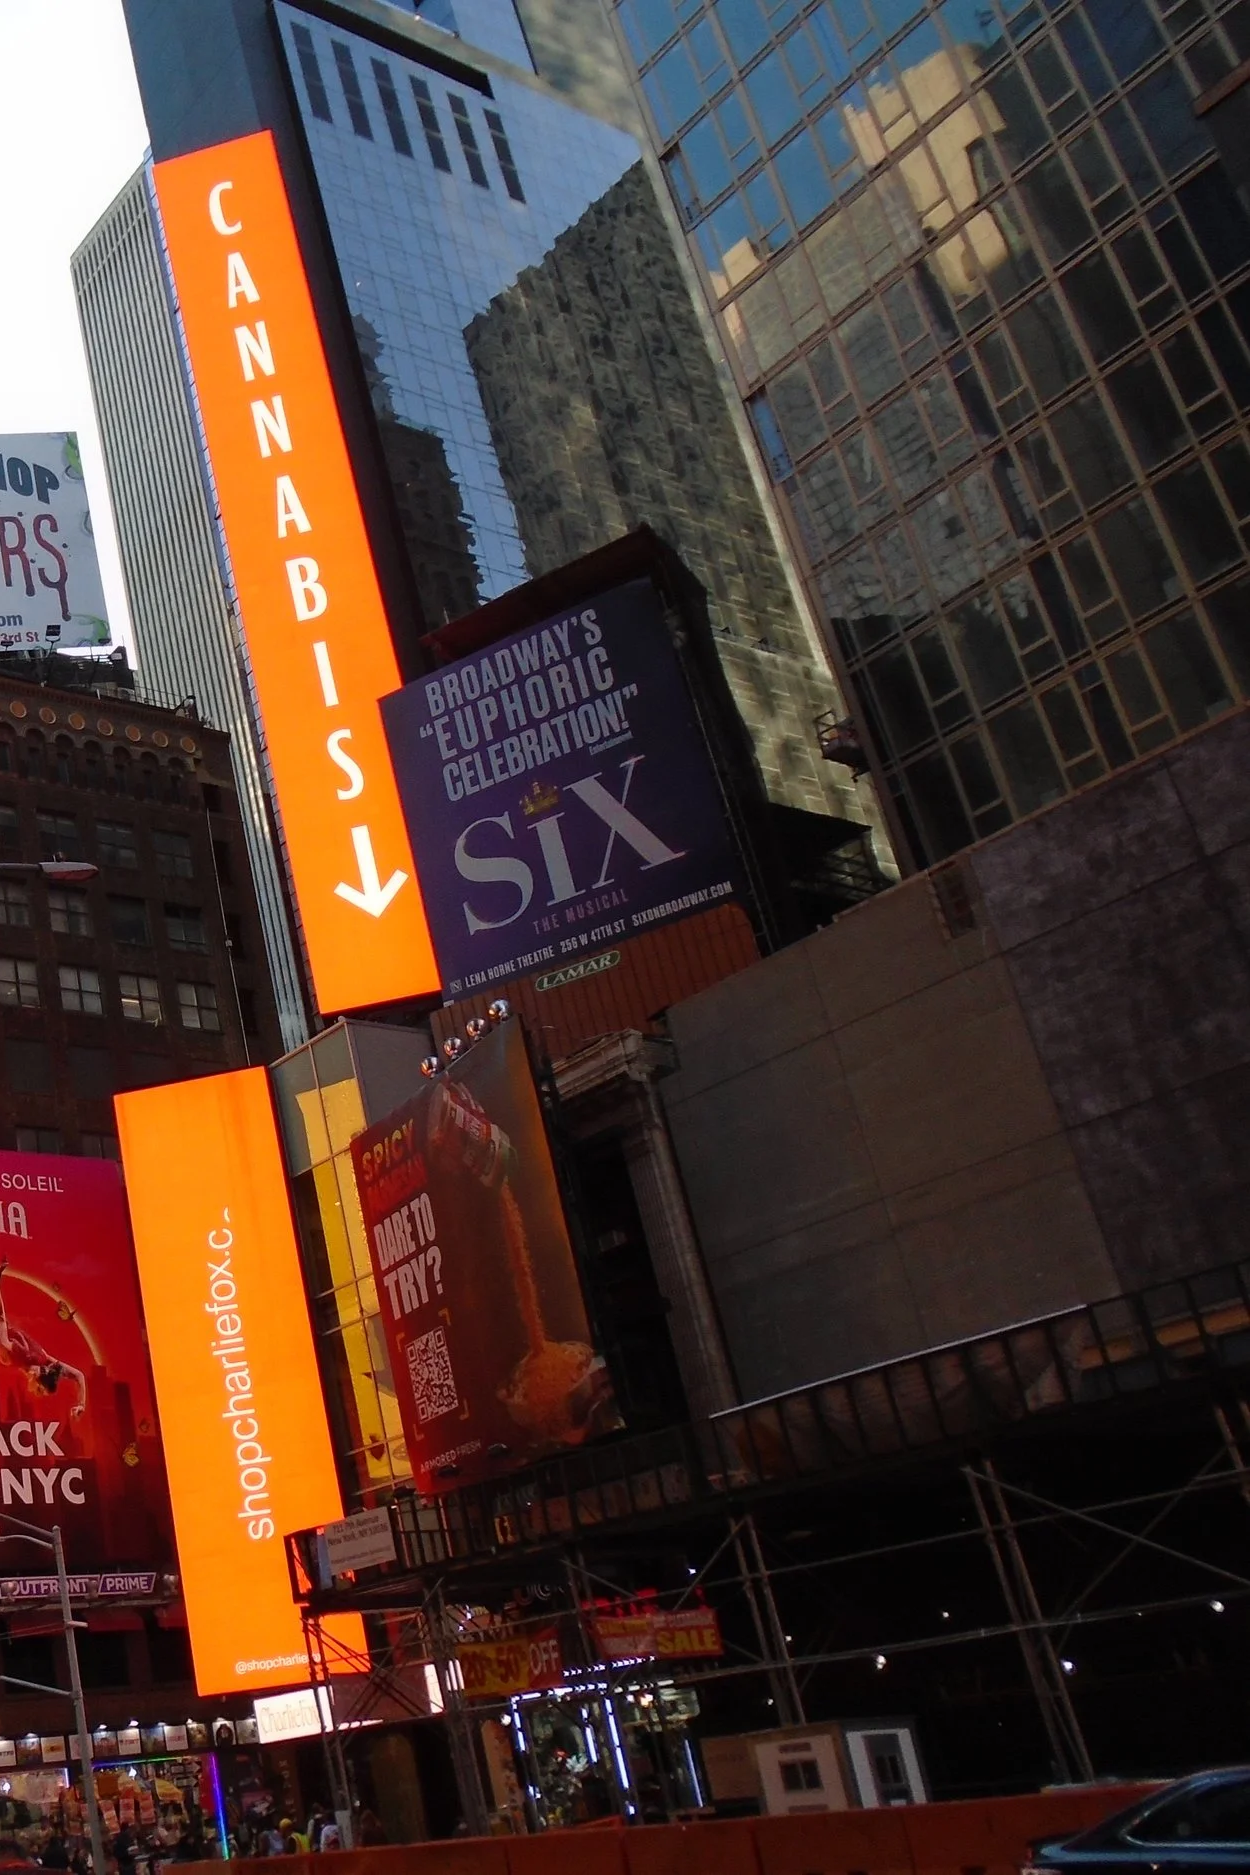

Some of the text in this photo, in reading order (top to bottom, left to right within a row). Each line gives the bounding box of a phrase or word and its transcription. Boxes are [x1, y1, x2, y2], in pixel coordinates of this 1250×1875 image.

[209, 181, 366, 801] CANNABIS
[26, 630, 40, 642] St
[425, 608, 602, 717] BROADWAY'S
[454, 755, 686, 936] SIX
[465, 971, 487, 988] LENA
[488, 961, 517, 979] HORNE
[517, 945, 555, 972] THEATRE
[579, 932, 589, 947] W
[590, 924, 613, 943] 47TH
[614, 918, 626, 936] ST
[632, 880, 735, 928] SIXONBROADWAY.COM
[533, 889, 629, 936] THE MUSICAL
[543, 953, 613, 989] LAMAR
[362, 1118, 416, 1182] SPICY
[1, 1173, 64, 1193] SOLEIL
[374, 1192, 437, 1271] DARE TO
[383, 1246, 444, 1321] TRY?
[0, 1467, 86, 1505] NYC
[6, 1576, 149, 1596] UTFRNT PRIME
[530, 1639, 559, 1676] OFF
[658, 1628, 719, 1654] SALE
